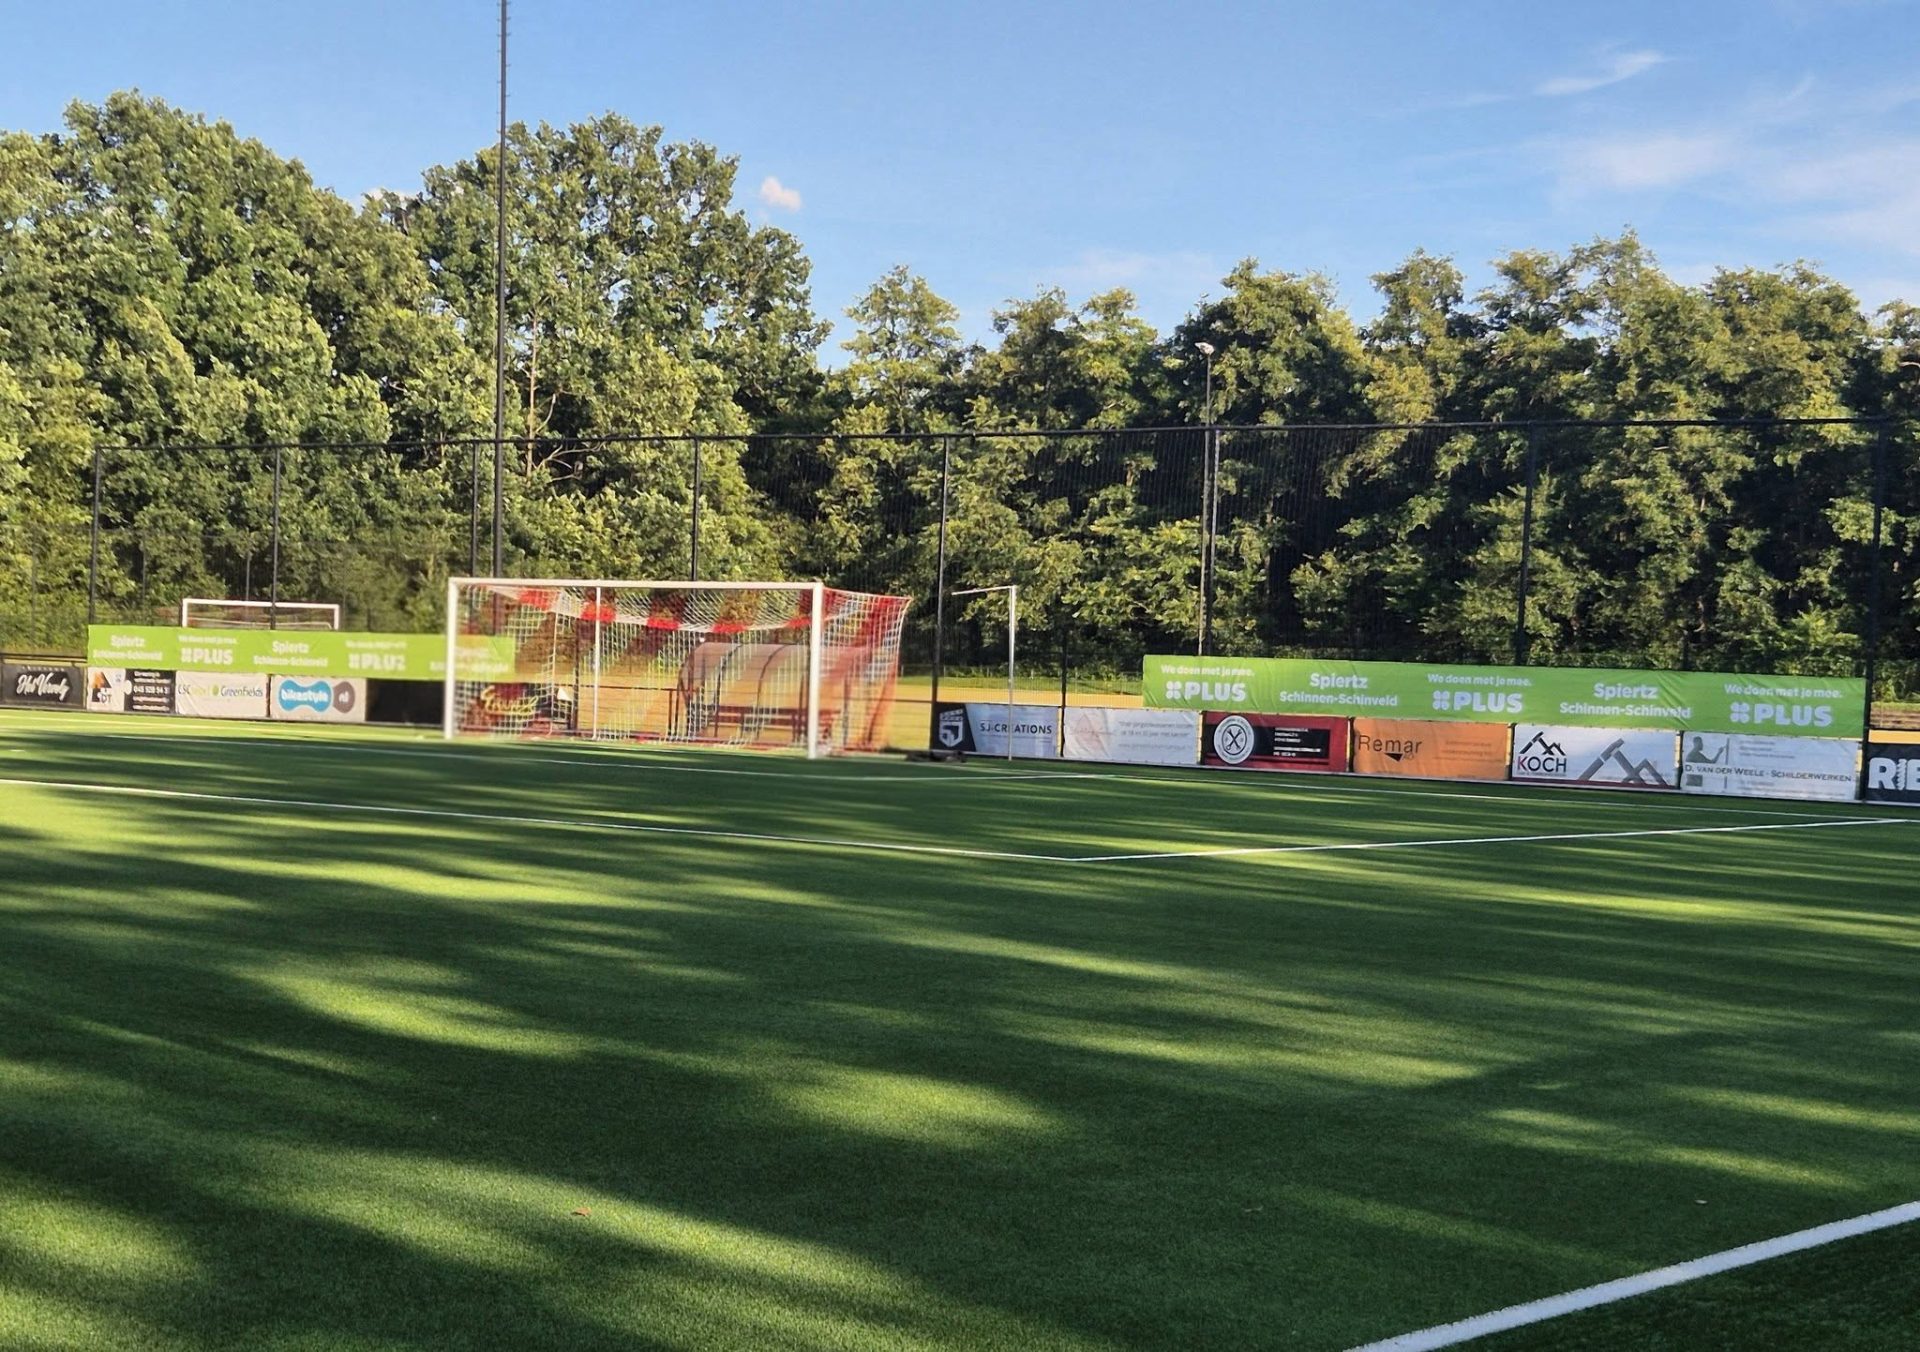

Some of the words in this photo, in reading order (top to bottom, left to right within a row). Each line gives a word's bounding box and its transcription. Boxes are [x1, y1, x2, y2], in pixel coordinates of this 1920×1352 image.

[193, 648, 233, 665] PLUS
[1161, 665, 1175, 674] We
[1177, 665, 1200, 675] doen
[1201, 666, 1220, 676] met
[1428, 673, 1443, 683] We
[1445, 674, 1472, 684] doen
[1473, 676, 1494, 685] met
[1309, 672, 1368, 689] Spiertz
[1184, 681, 1246, 702] PLUS
[1280, 691, 1398, 706] Schinnen-Schinveld
[1594, 683, 1658, 700] Spiertz
[1724, 683, 1742, 695] We
[1743, 685, 1773, 696] doen
[1775, 687, 1799, 697] met
[1453, 691, 1523, 714] PLUS
[1559, 702, 1691, 719] Schinnen-Schinveld
[1753, 703, 1833, 727] PLUS
[980, 722, 1052, 735] SJ-CRATIONS
[1358, 735, 1422, 753] Remar
[1517, 755, 1567, 773] KOCH
[1735, 767, 1764, 778] WEELE
[1771, 769, 1851, 782] SCHILDERWERKEN
